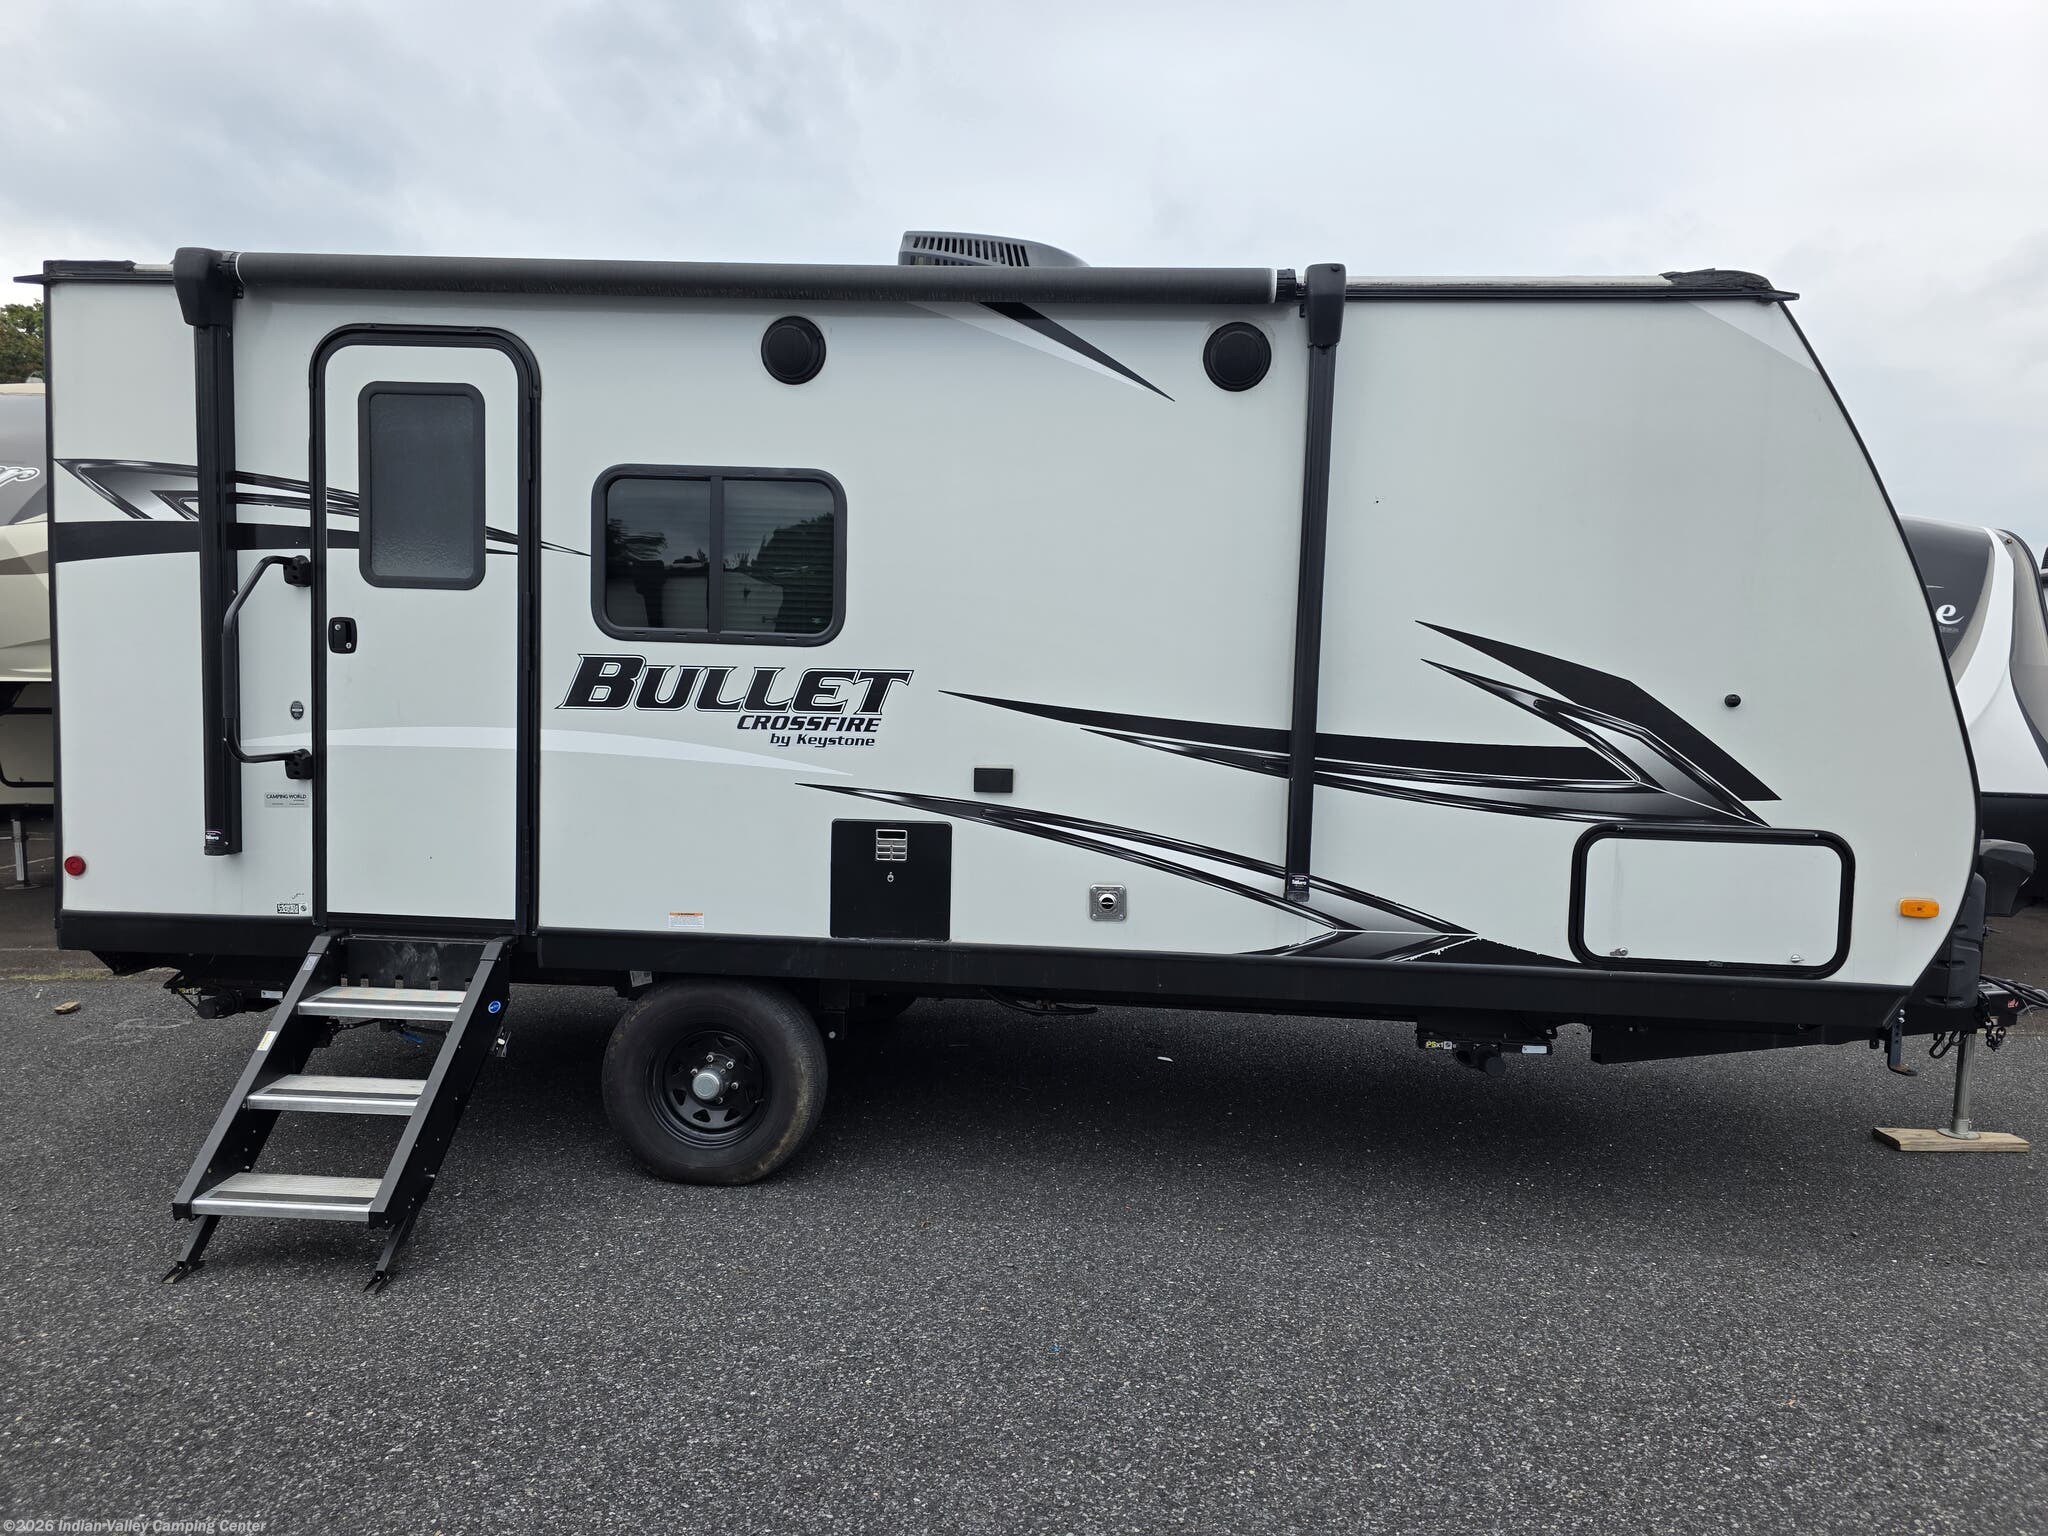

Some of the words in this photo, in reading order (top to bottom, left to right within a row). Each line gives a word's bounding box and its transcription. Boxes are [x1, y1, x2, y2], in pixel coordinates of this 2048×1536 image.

[554, 653, 915, 715] BULLET
[737, 715, 882, 733] CROSSFIRE
[770, 733, 791, 747] by
[796, 734, 876, 748] Keystone
